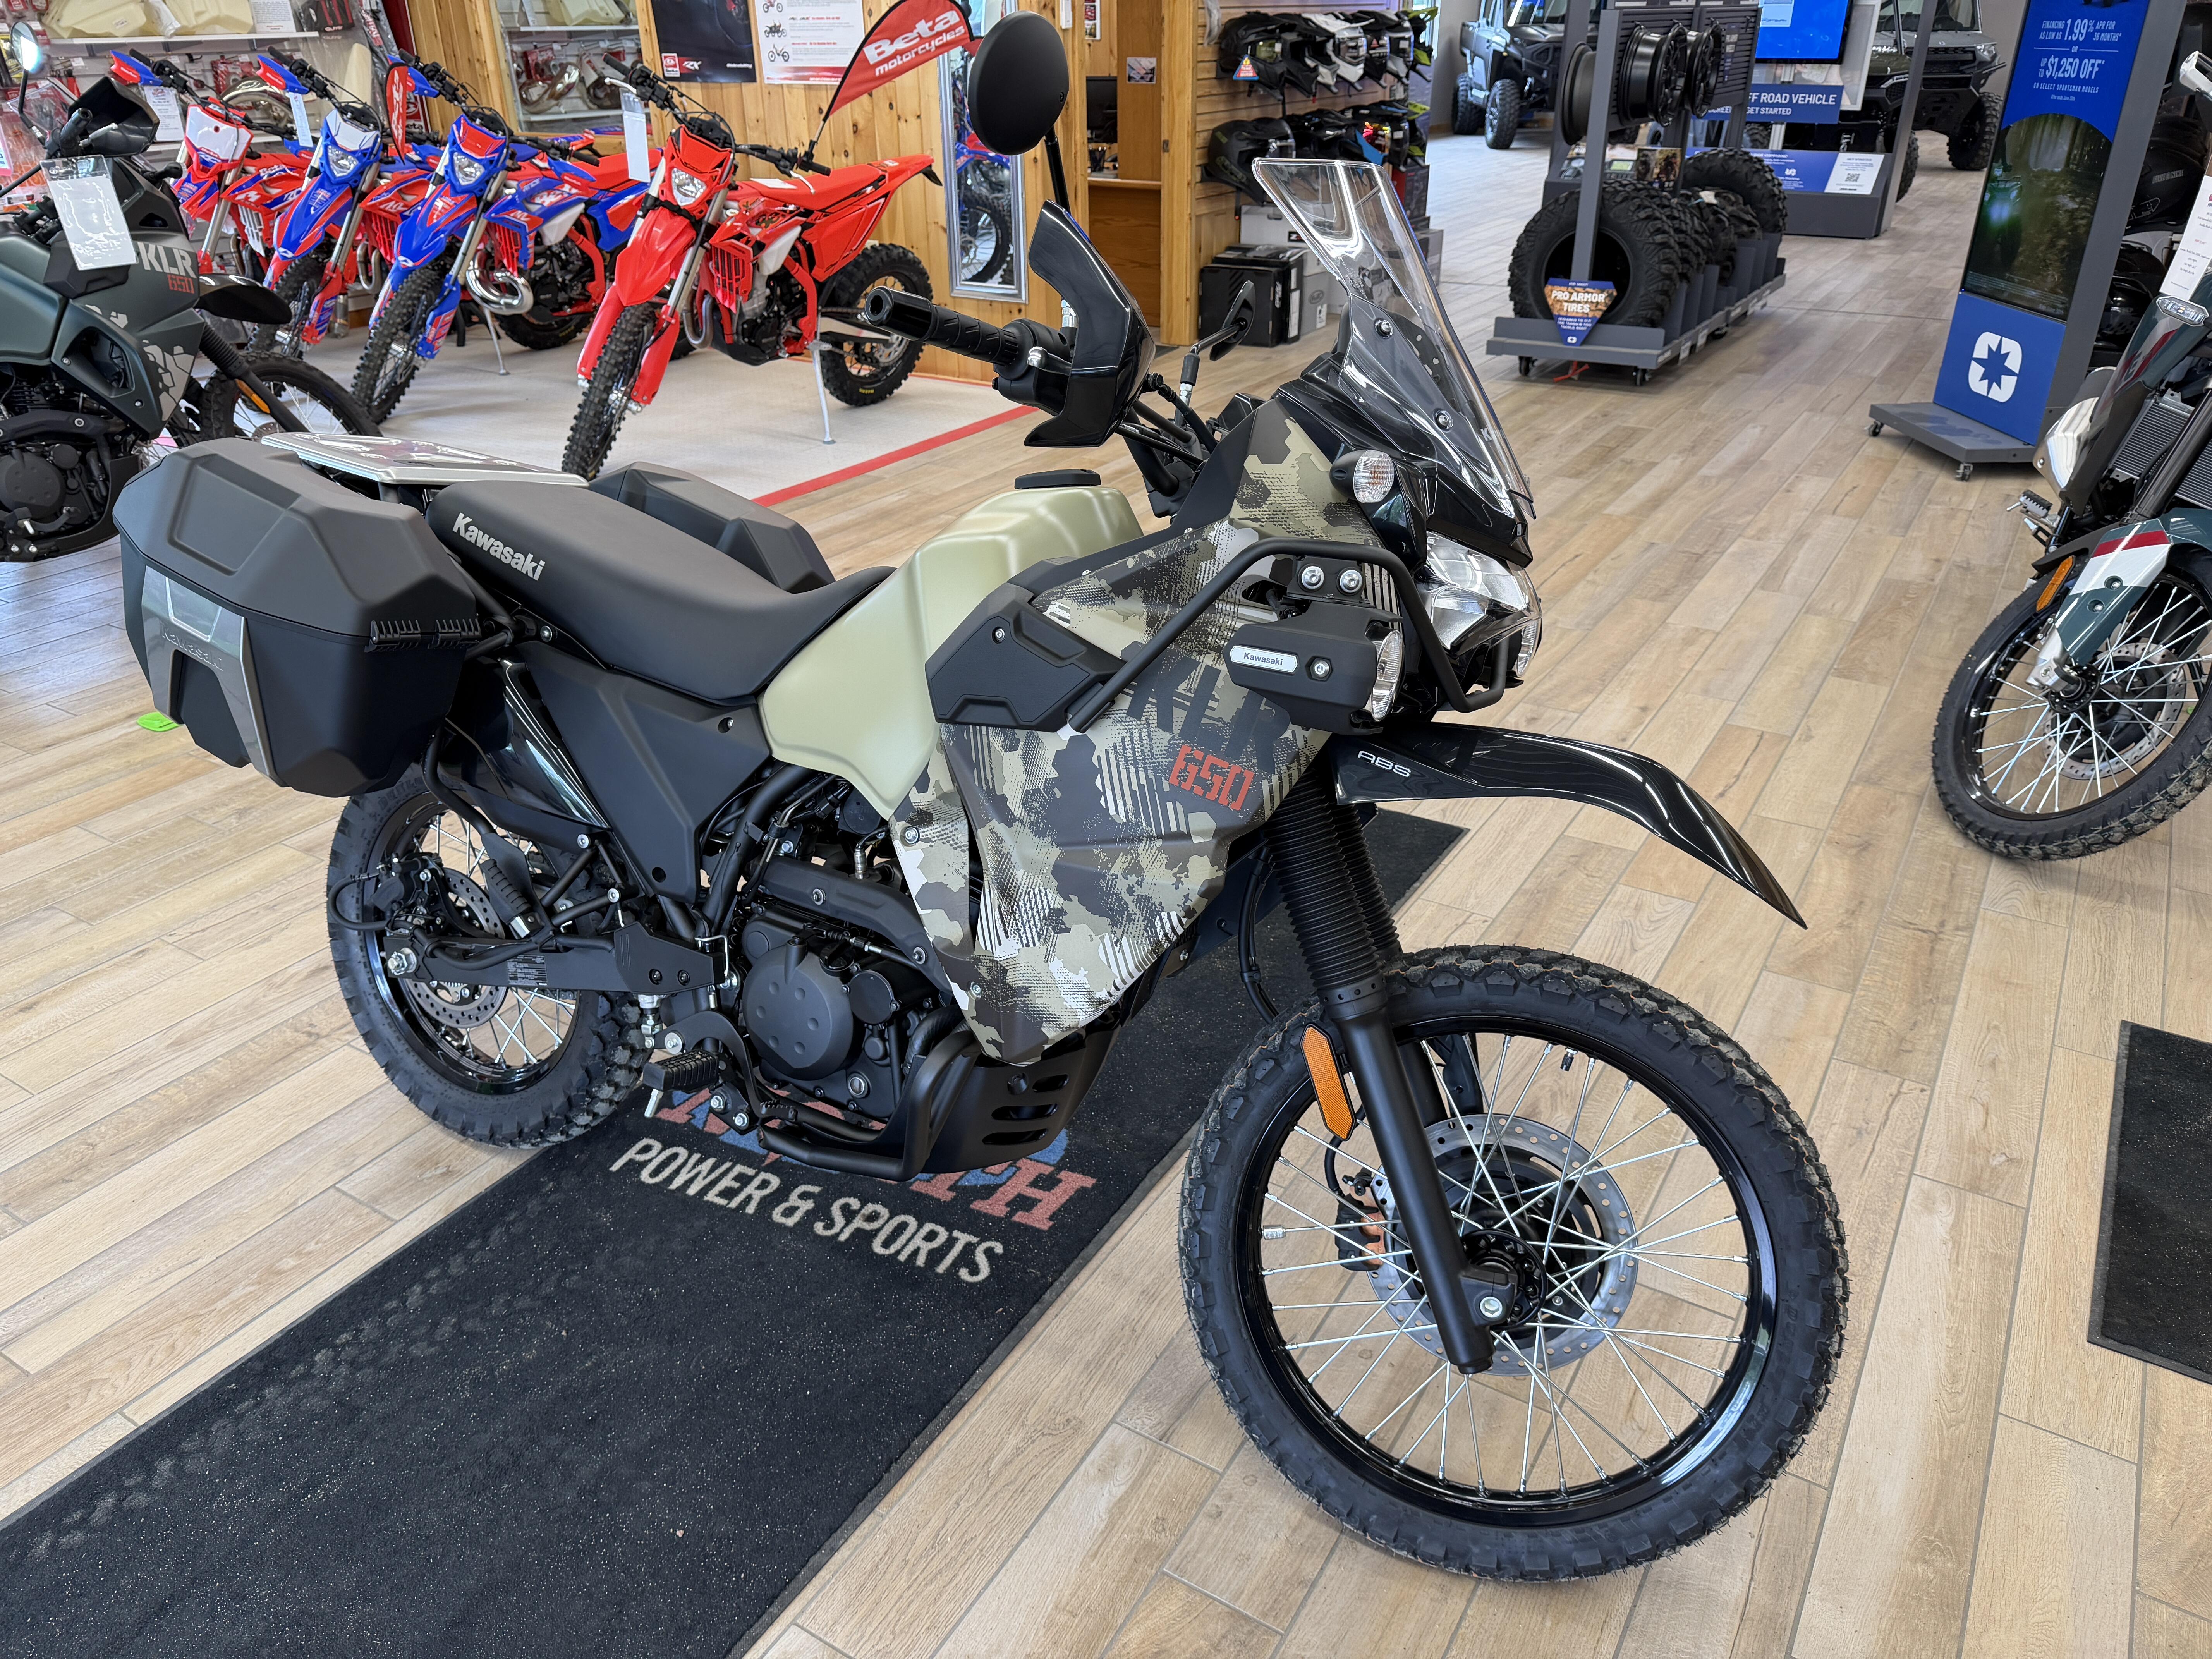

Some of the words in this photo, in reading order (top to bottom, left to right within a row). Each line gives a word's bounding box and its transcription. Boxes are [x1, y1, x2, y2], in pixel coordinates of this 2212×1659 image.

[2039, 31, 2045, 40] AS
[2055, 32, 2063, 40] AS
[2042, 21, 2065, 29] FINANCING
[2095, 21, 2106, 29] APR
[2106, 21, 2116, 30] FOR
[863, 10, 960, 65] Beta
[875, 26, 965, 77] motorcycles
[2039, 69, 2045, 78] TO
[2046, 55, 2080, 79] $1,250
[1760, 93, 1790, 104] ROAD
[1791, 94, 1837, 105] VEHICLE
[1760, 107, 1792, 115] STARTED
[137, 242, 197, 278] KLR
[167, 273, 195, 294] 650
[1551, 290, 1570, 300] PRO
[1570, 292, 1606, 302] ARMOR
[1563, 302, 1590, 313] TIRES
[452, 512, 545, 581] Kawasaki
[160, 620, 223, 671] Kawasaki
[1243, 652, 1283, 666] Kawasaki
[1357, 750, 1411, 777] ABS
[1169, 745, 1254, 811] 650
[609, 1137, 781, 1214] POWER
[772, 1184, 822, 1227] &
[813, 1197, 1005, 1283] SPORTS
